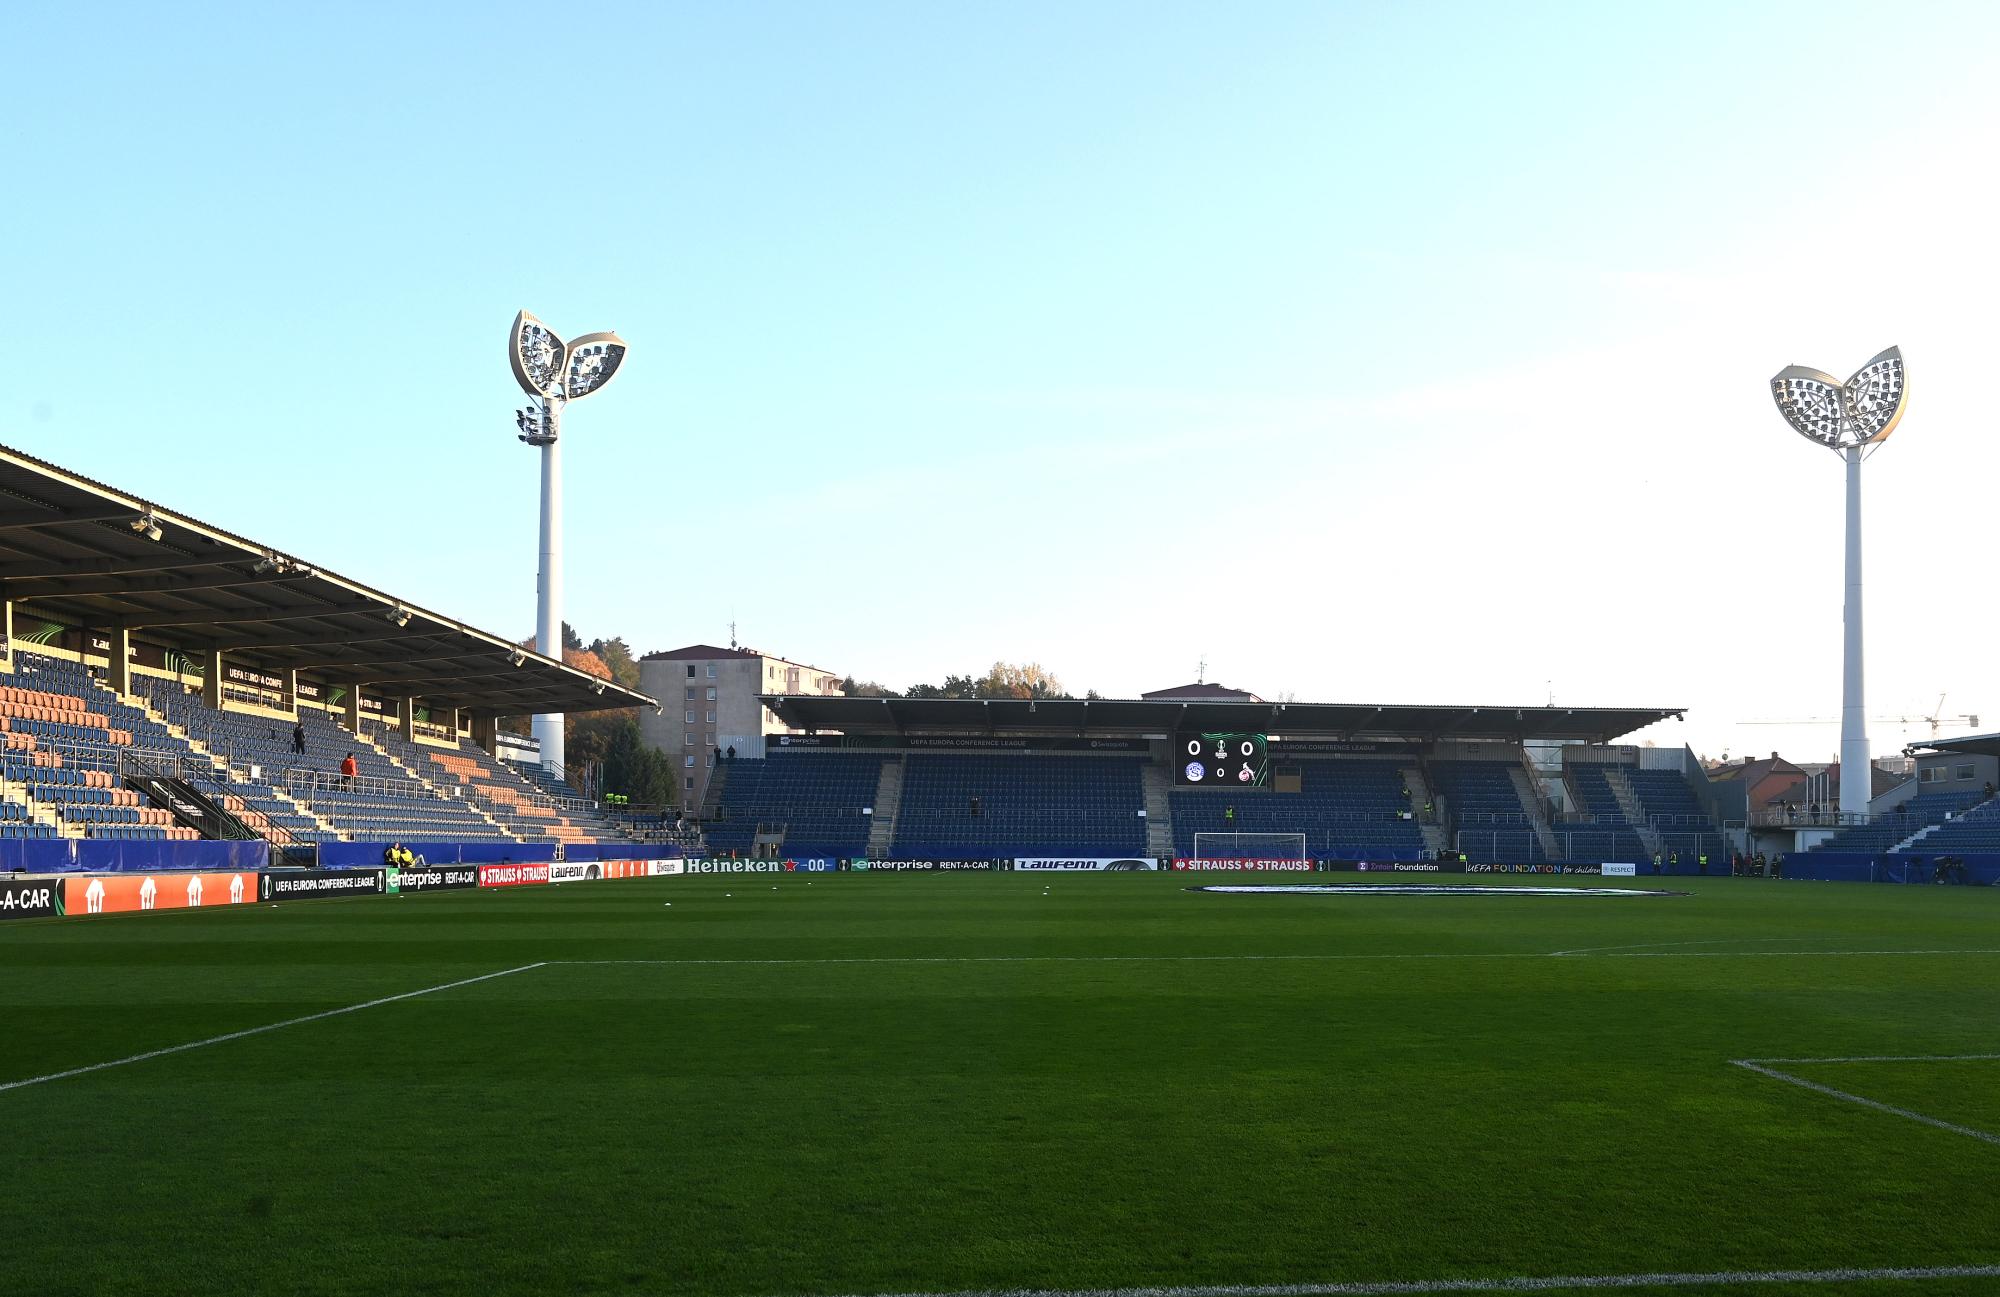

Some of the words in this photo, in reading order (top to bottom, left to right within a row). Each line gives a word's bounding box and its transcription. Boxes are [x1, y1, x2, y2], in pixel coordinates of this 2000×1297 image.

[229, 667, 244, 680] UEFA
[298, 684, 319, 697] LEAGUE
[955, 739, 1000, 747] CONFERENCE
[1187, 740, 1201, 756] 0
[1240, 741, 1254, 756] 0
[1308, 743, 1350, 751] CONFERENCE
[686, 858, 780, 873] Heineken
[854, 859, 933, 871] enterprise
[939, 861, 989, 869] RENT-A-CAR
[1188, 860, 1242, 871] STRAUSS
[1256, 860, 1310, 871] STRAUSS
[1394, 863, 1439, 871] Foundation
[1467, 863, 1491, 873] UEFA
[1493, 864, 1561, 873] FOUNDATION
[1562, 865, 1572, 874] for
[1574, 865, 1601, 874] children
[389, 868, 442, 890] enterprise
[445, 871, 475, 884] RENT-A-CAR
[487, 867, 516, 884] STRAUSS
[522, 866, 548, 882] STRAUSS
[275, 880, 292, 892] UEFA
[293, 879, 318, 891] EUROPA
[318, 877, 354, 890] CONFERENCE
[354, 876, 375, 888] LEAGUE
